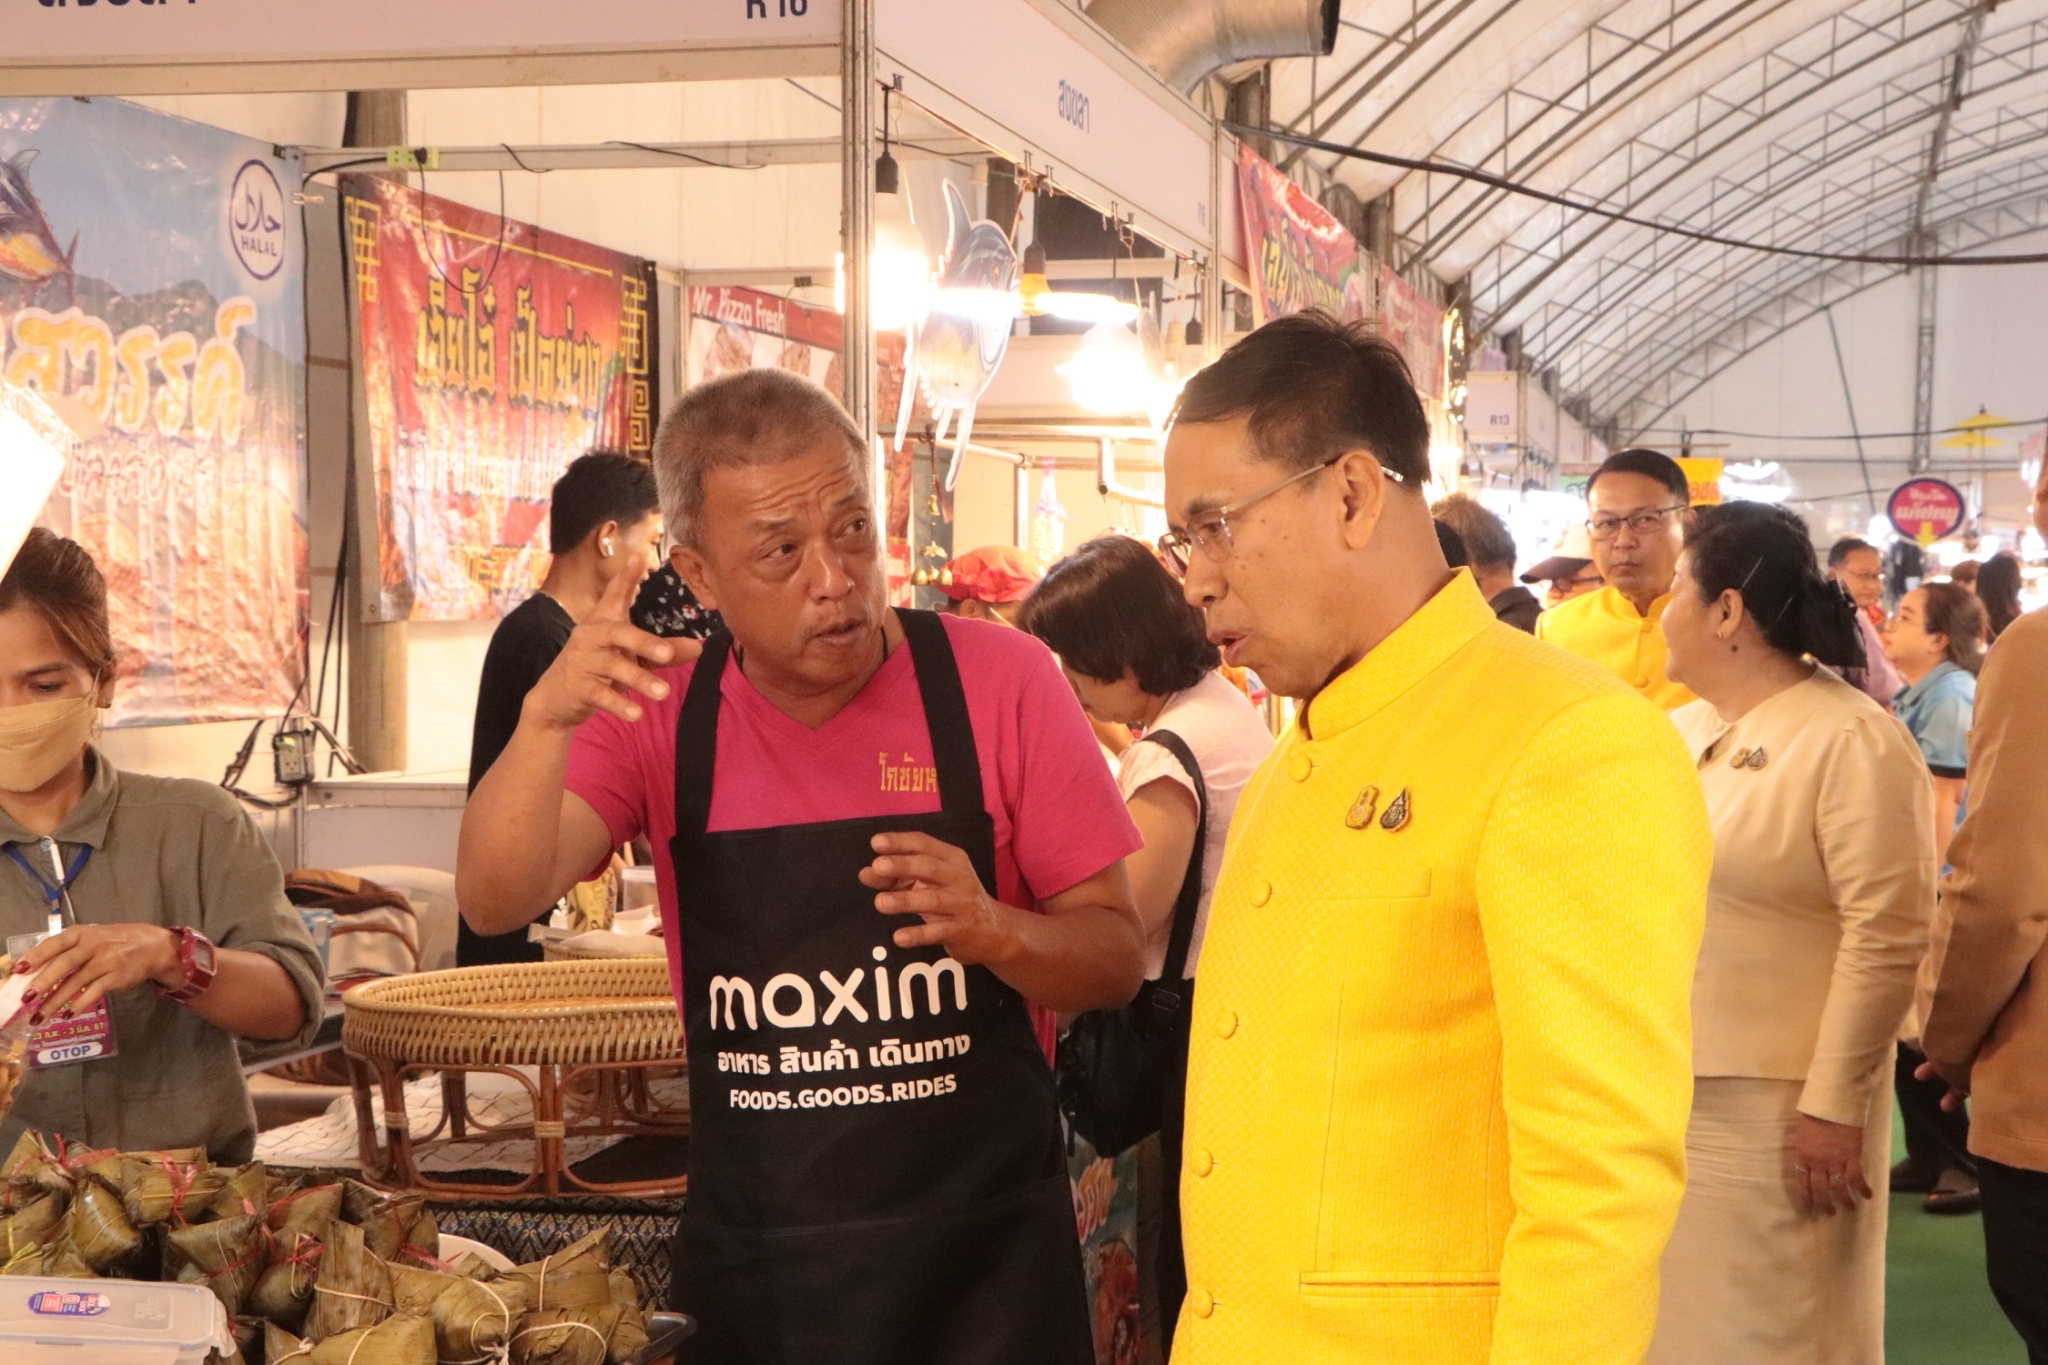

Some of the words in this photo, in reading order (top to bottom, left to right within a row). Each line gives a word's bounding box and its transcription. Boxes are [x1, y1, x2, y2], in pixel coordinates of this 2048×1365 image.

[1058, 79, 1090, 134] สงขลา
[241, 234, 278, 257] HALAL
[692, 286, 714, 317] Mr.
[717, 287, 753, 327] Pizza
[756, 297, 786, 335] Fresh
[1490, 414, 1510, 426] R13
[709, 945, 969, 1031] maxim
[93, 1022, 104, 1031] 67
[50, 1045, 91, 1061] OTOP
[717, 1050, 771, 1075] อาหาร
[779, 1038, 859, 1074] สินค้า
[868, 1033, 971, 1068] เดินทาง
[729, 1073, 957, 1110] FOODS.GOODS.RIDES
